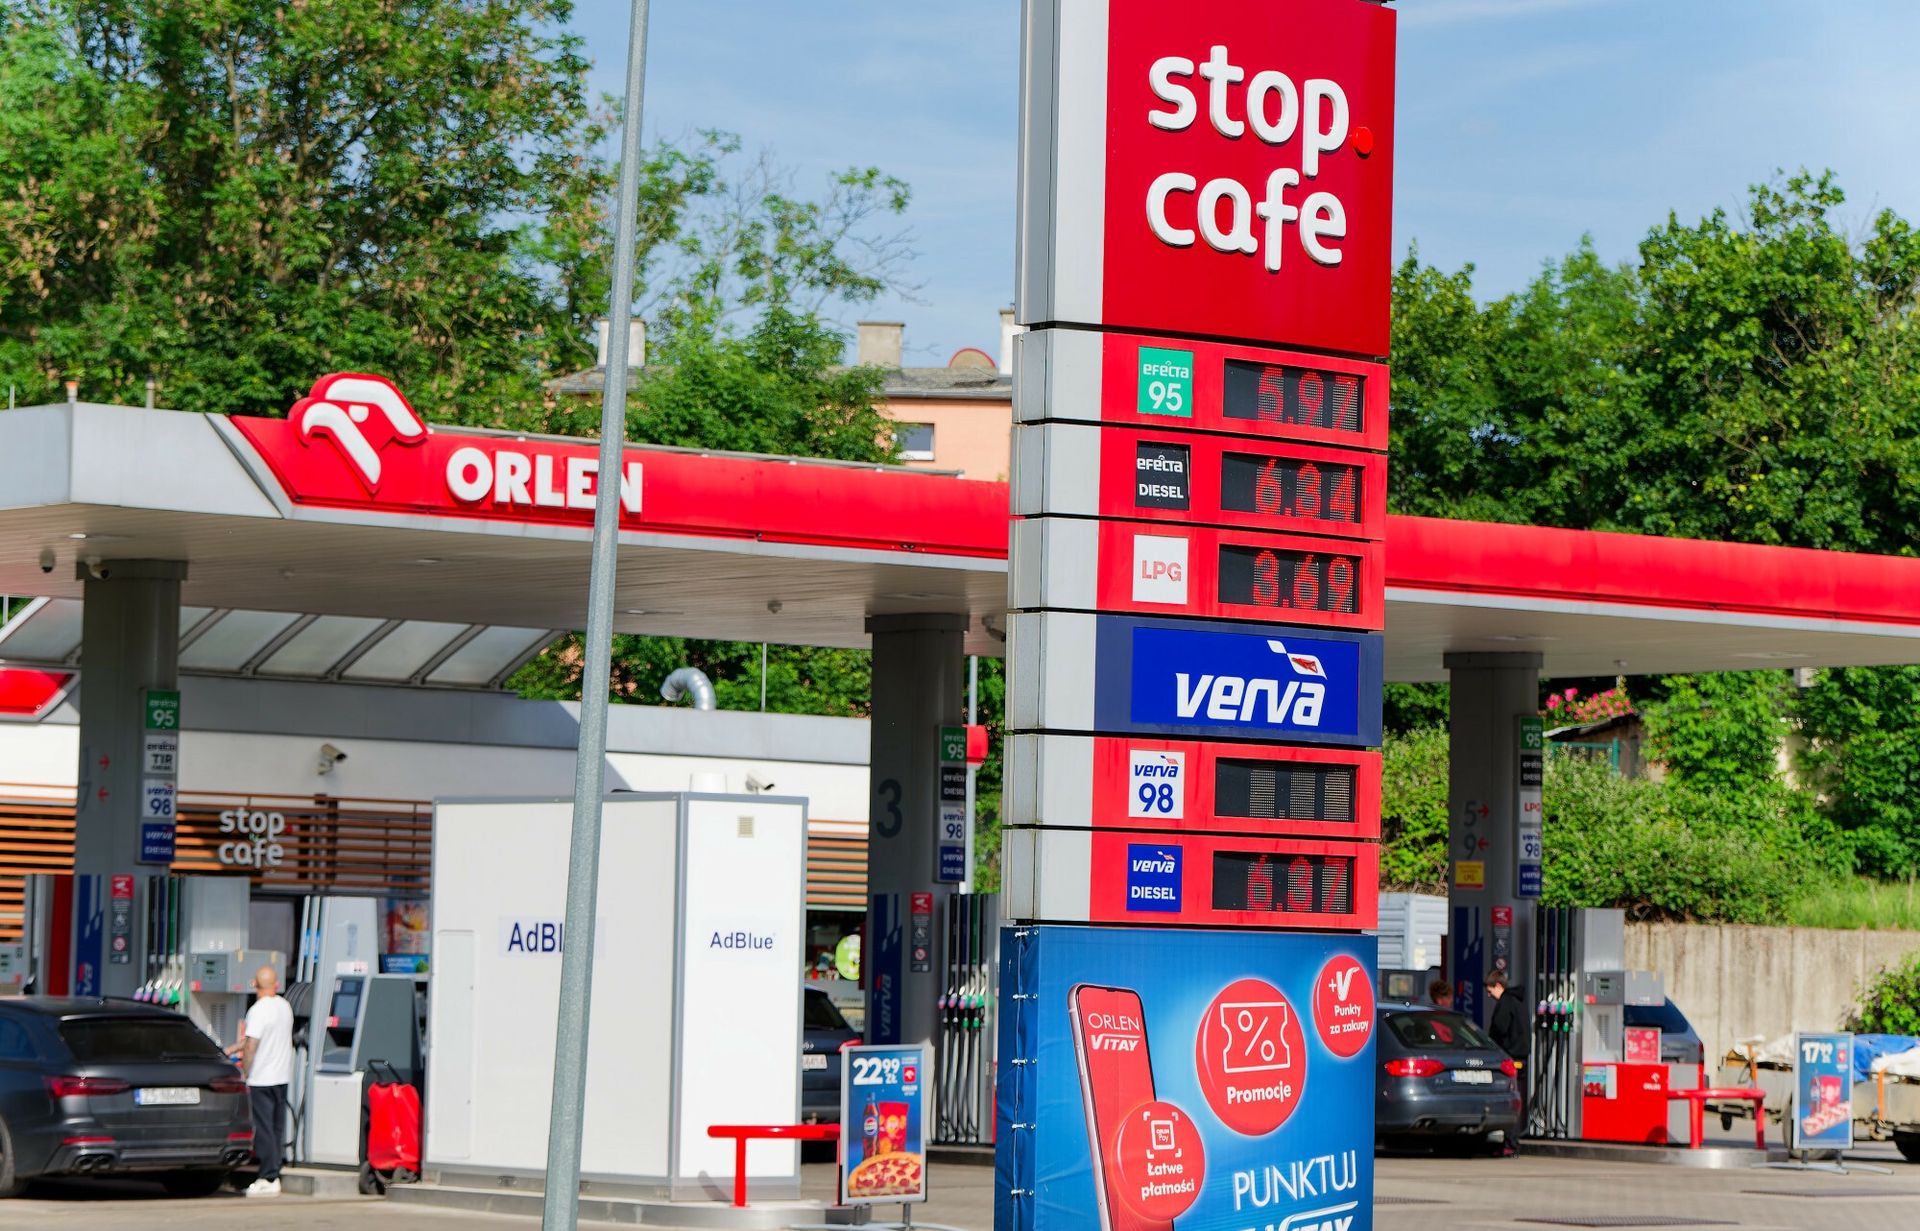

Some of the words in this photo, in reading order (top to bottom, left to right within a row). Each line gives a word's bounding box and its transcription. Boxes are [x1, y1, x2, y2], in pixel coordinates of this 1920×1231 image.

[1146, 167, 1347, 271] cafe
[1148, 381, 1182, 411] 95
[1257, 367, 1359, 431] 5.97
[446, 447, 643, 513] ORLEN
[1139, 483, 1184, 499] DIESEL
[1256, 459, 1355, 522] 6.34
[1141, 559, 1182, 582] LPG
[1253, 550, 1353, 613] 3.69
[1175, 672, 1326, 726] verva
[153, 709, 175, 726] 95
[152, 754, 173, 764] TIR
[947, 744, 964, 759] 95
[1134, 764, 1178, 778] verva
[150, 798, 172, 815] 98
[876, 779, 903, 839] 3
[1138, 783, 1173, 813] 98
[1464, 801, 1477, 827] 5
[946, 823, 963, 839] 98
[219, 839, 284, 868] cafe
[1463, 833, 1477, 860] 9
[1525, 842, 1540, 857] 98
[1132, 859, 1175, 874] verva
[1131, 886, 1176, 900] DIESEL
[1247, 854, 1348, 912] 6.37
[1088, 1012, 1140, 1031] ORLEN
[1334, 1003, 1361, 1017] Punkty
[1330, 1024, 1341, 1035] za
[1342, 1019, 1369, 1033] zakupy
[1227, 1080, 1292, 1105] Promocje
[1147, 1161, 1184, 1177] Łatwe
[1234, 1150, 1357, 1211] PUNKTUJ
[1141, 1178, 1195, 1201] płatności
